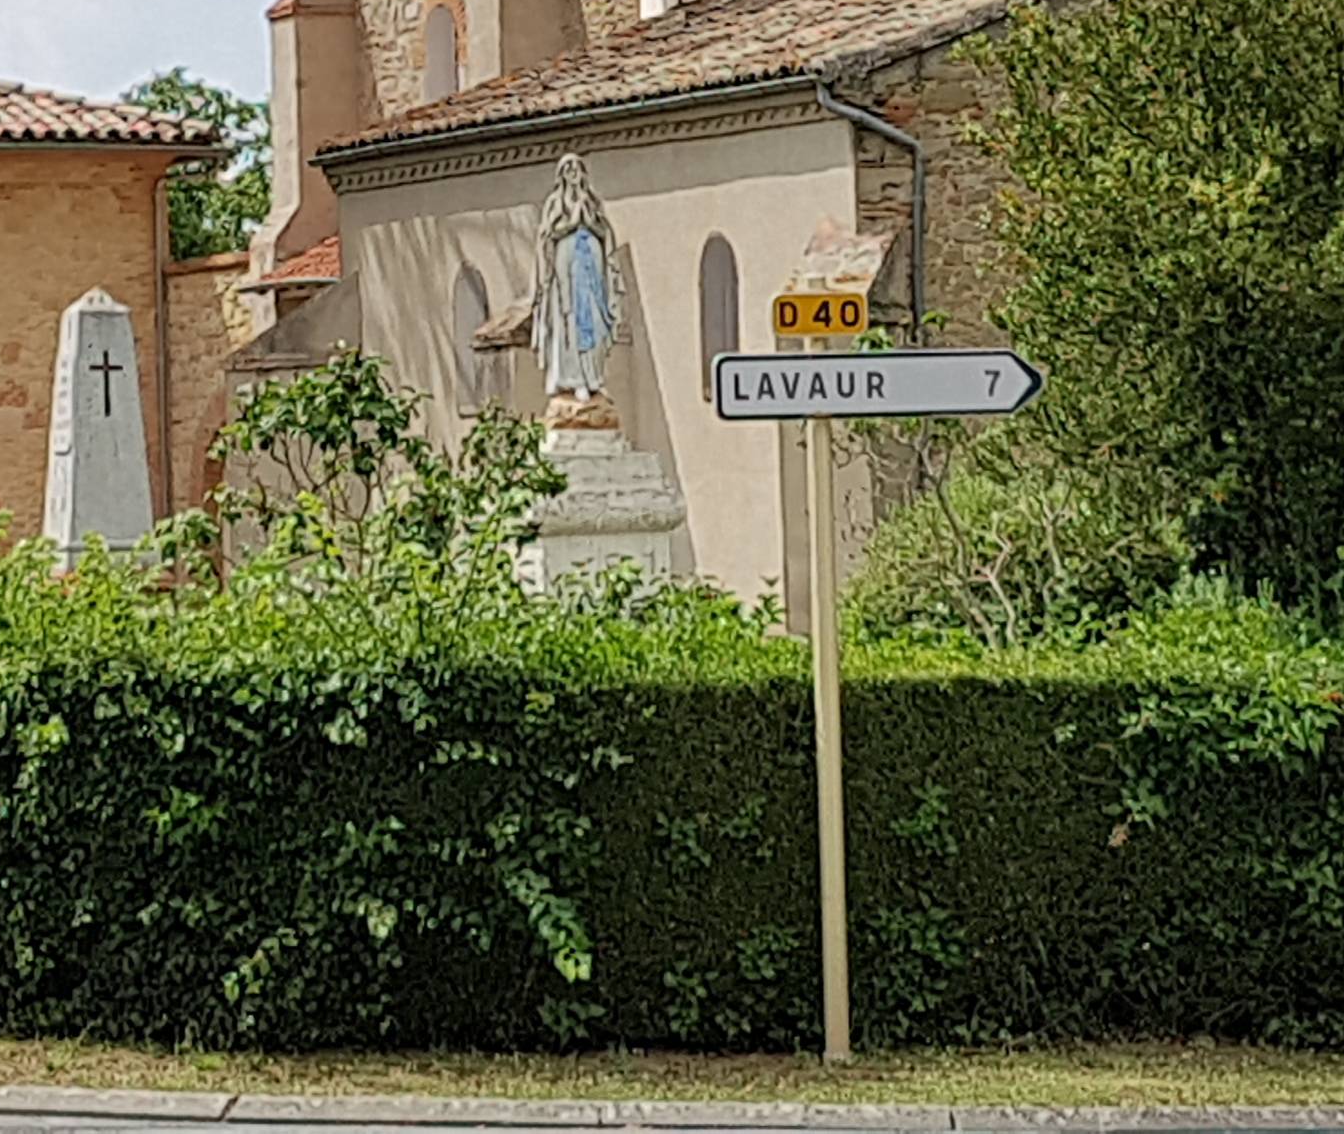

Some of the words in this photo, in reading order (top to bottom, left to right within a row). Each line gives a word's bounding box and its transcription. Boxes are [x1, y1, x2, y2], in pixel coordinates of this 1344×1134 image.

[779, 301, 798, 328] D
[812, 300, 860, 328] 40
[734, 371, 886, 401] LAVAUR
[984, 370, 1002, 398] 7
